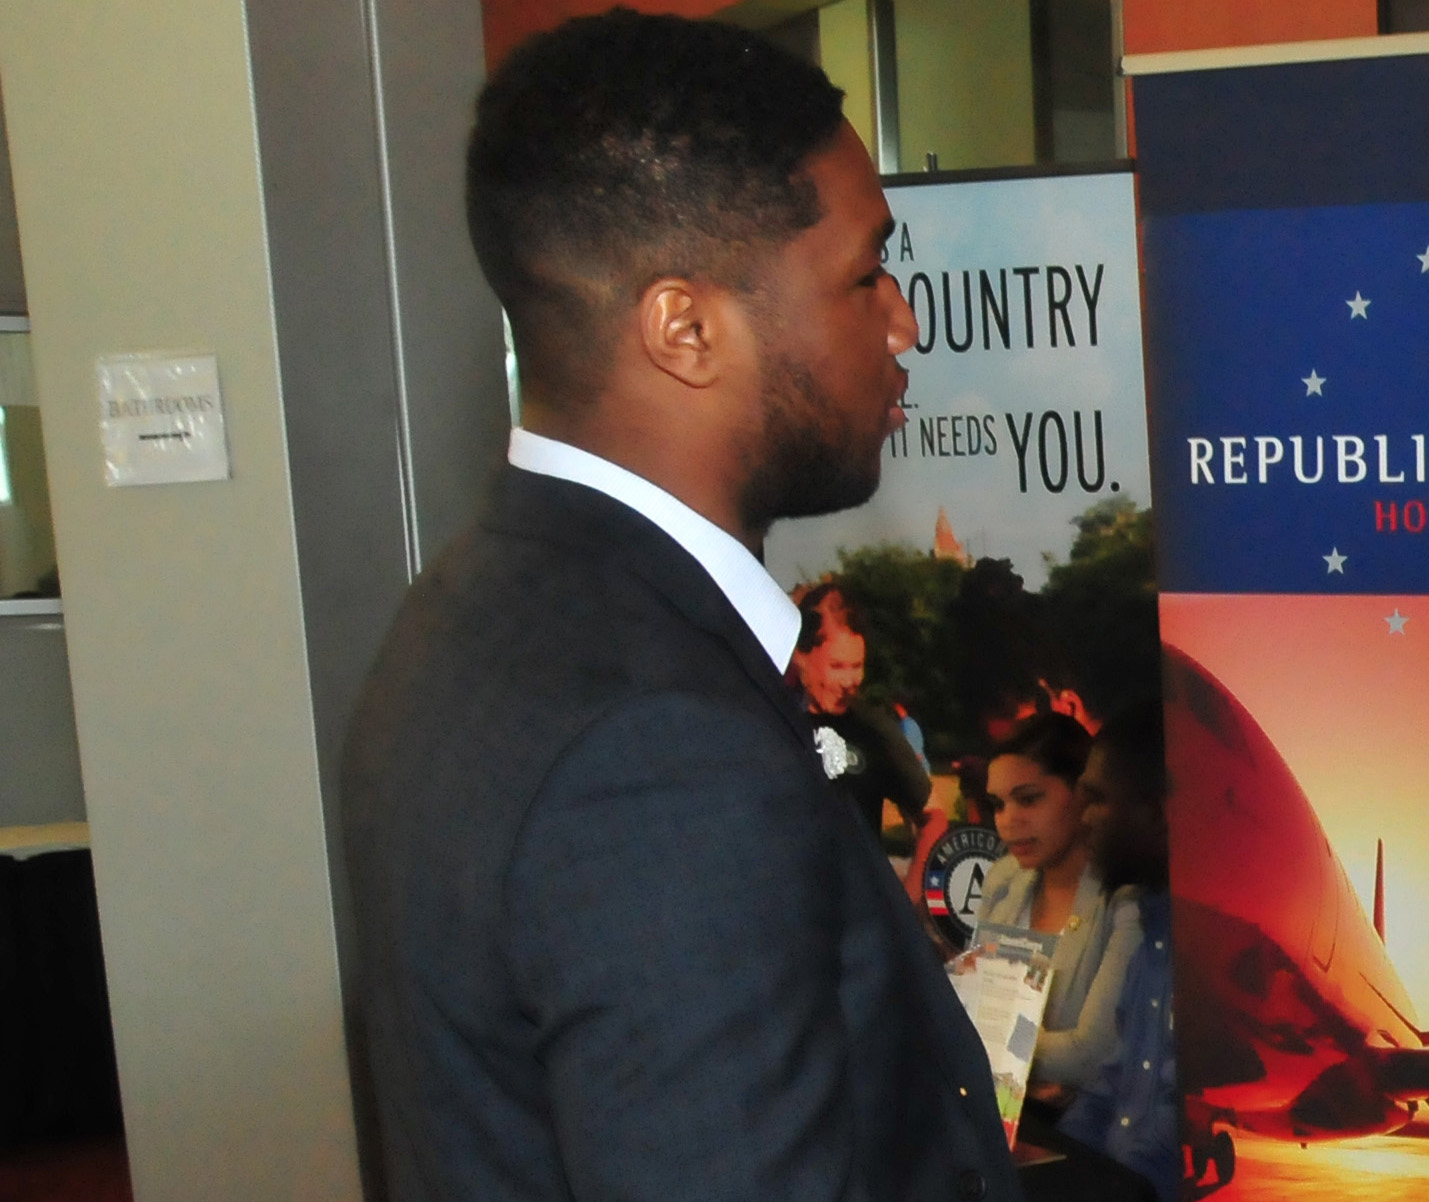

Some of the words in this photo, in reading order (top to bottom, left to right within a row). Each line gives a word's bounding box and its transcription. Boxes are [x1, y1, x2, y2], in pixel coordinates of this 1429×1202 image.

[900, 221, 915, 262] A
[905, 263, 1105, 355] OUNTRY
[919, 414, 998, 458] NEEDS
[1004, 409, 1121, 494] YOU.
[936, 832, 1007, 865] AMERICO
